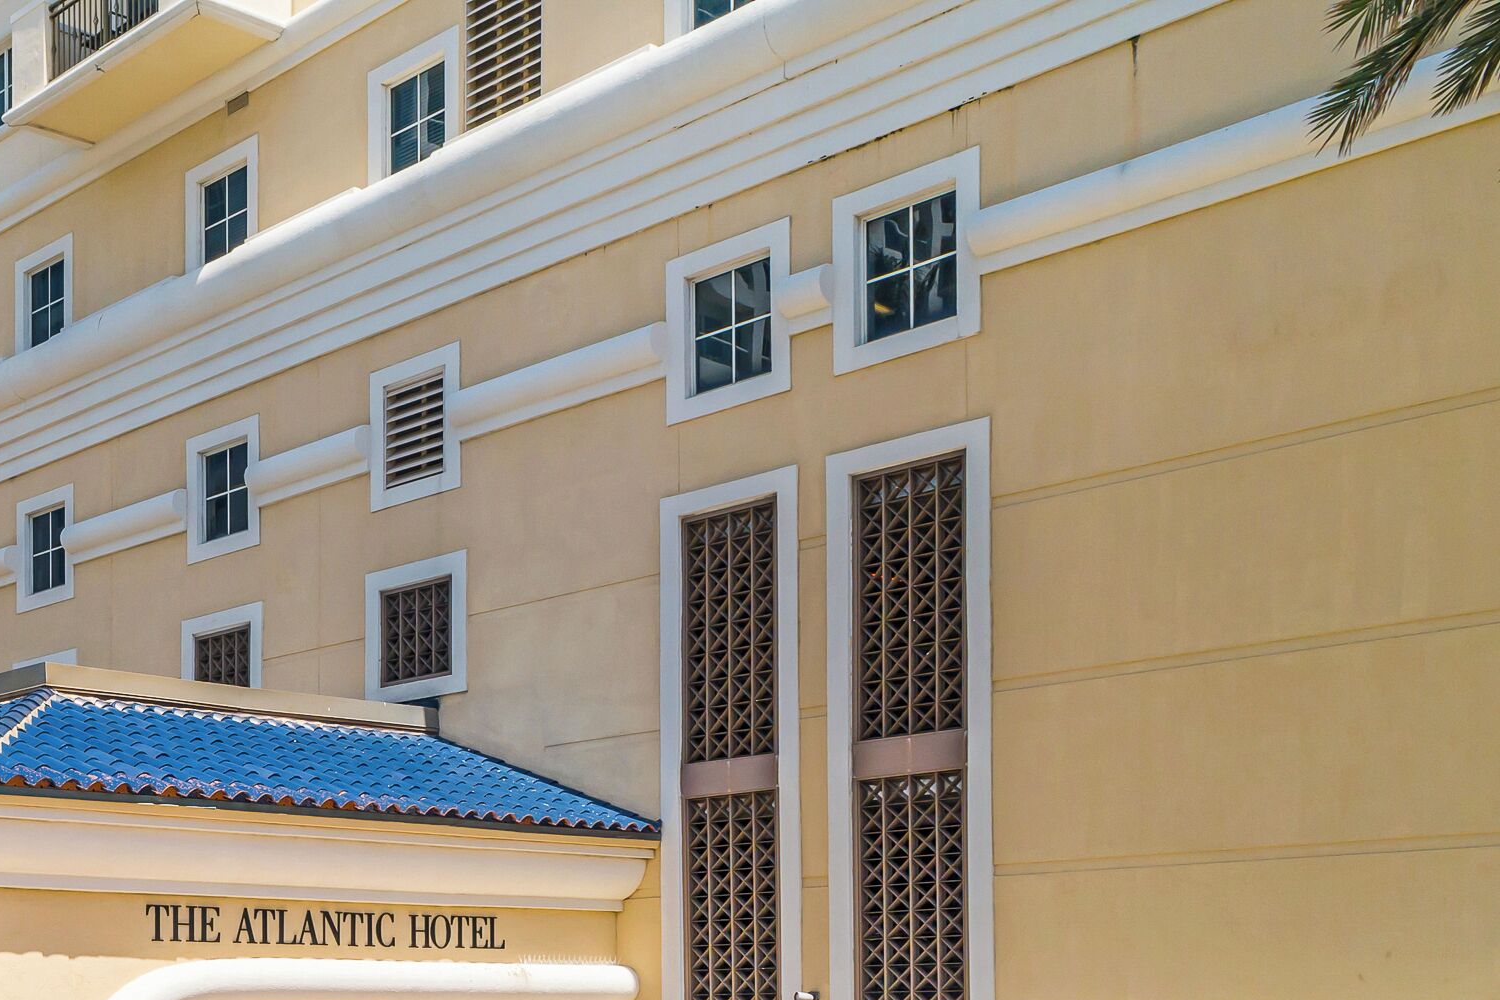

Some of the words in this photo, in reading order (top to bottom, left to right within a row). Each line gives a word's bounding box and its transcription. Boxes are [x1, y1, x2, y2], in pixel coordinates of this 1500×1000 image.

[146, 904, 220, 943] THE
[233, 907, 395, 948] ATLANTIC
[408, 914, 506, 950] HOTEL
